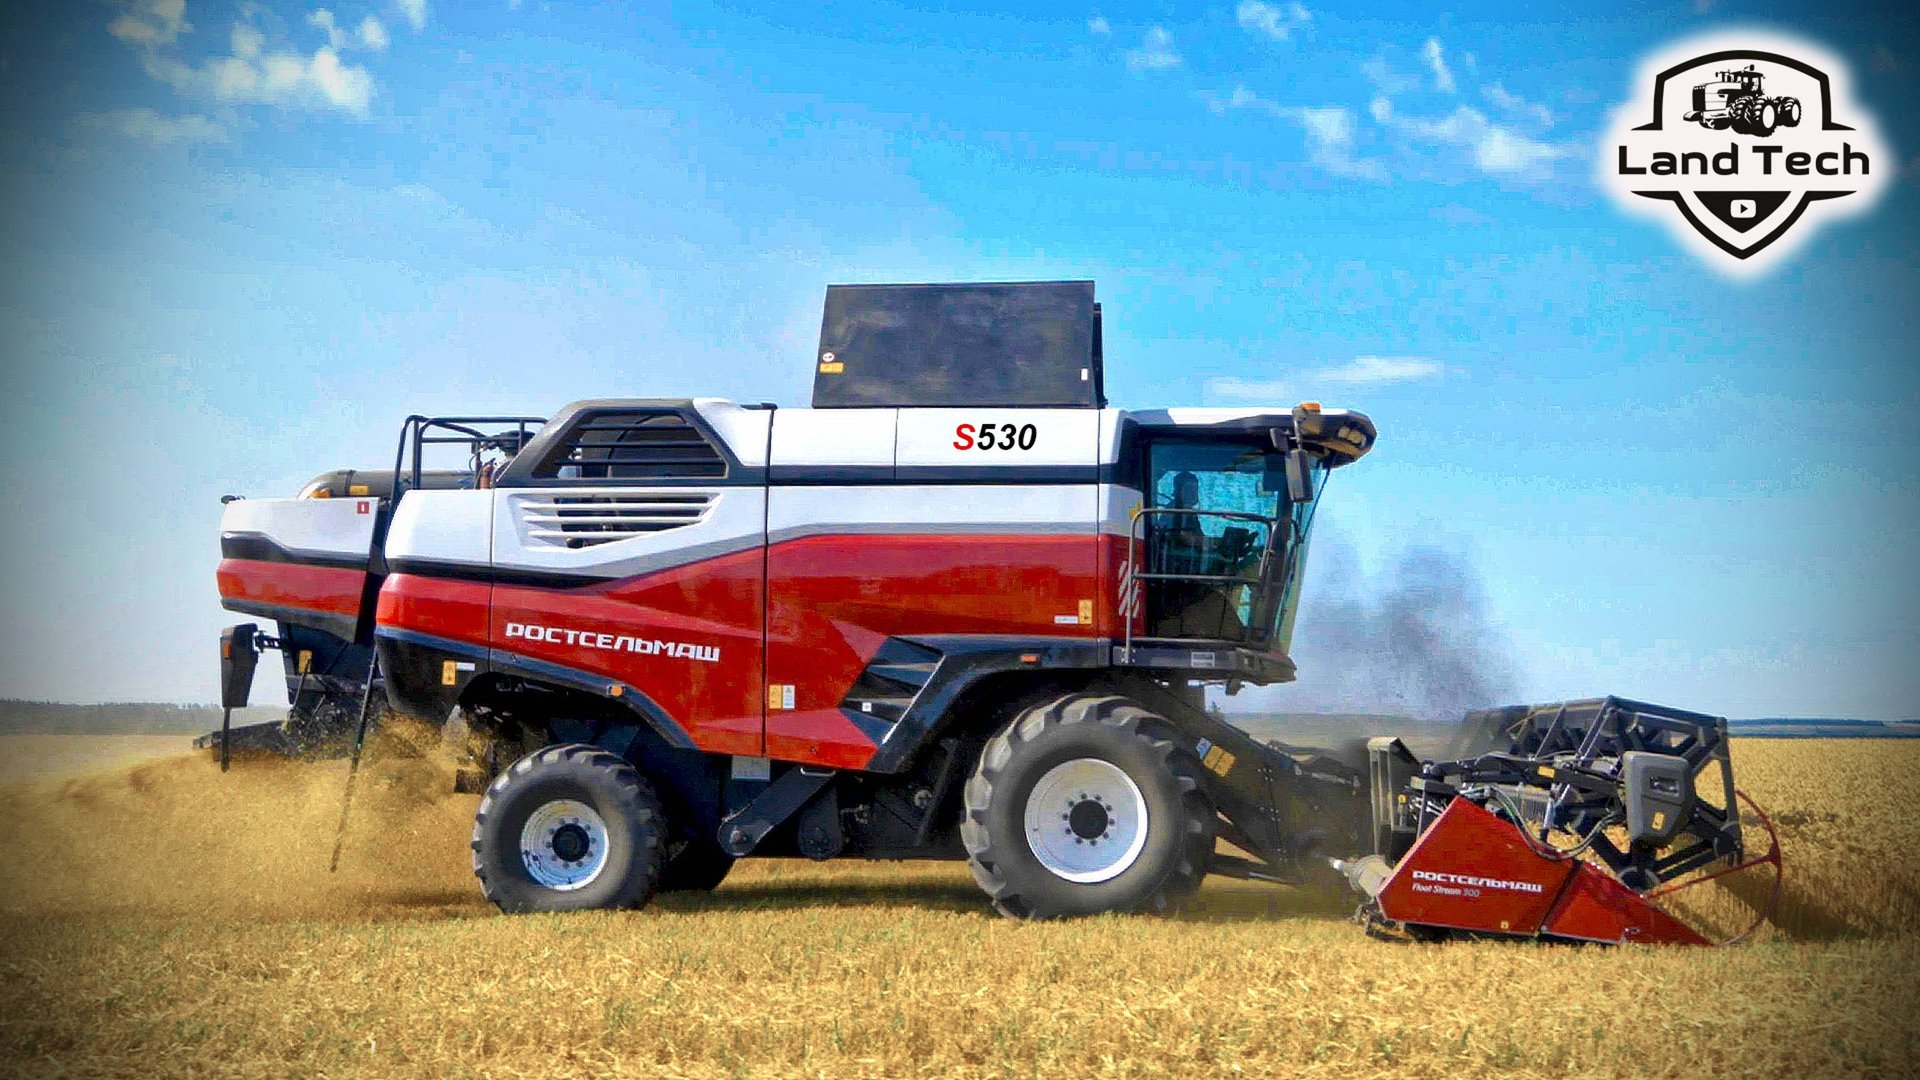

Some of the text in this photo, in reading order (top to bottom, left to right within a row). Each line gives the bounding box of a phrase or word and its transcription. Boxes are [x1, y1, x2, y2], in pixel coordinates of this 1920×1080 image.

[953, 423, 1037, 451] S530
[505, 622, 720, 662] РОСТСЕЛЬМАШ
[1412, 870, 1542, 893] РОСТСЕЛЬМАШ
